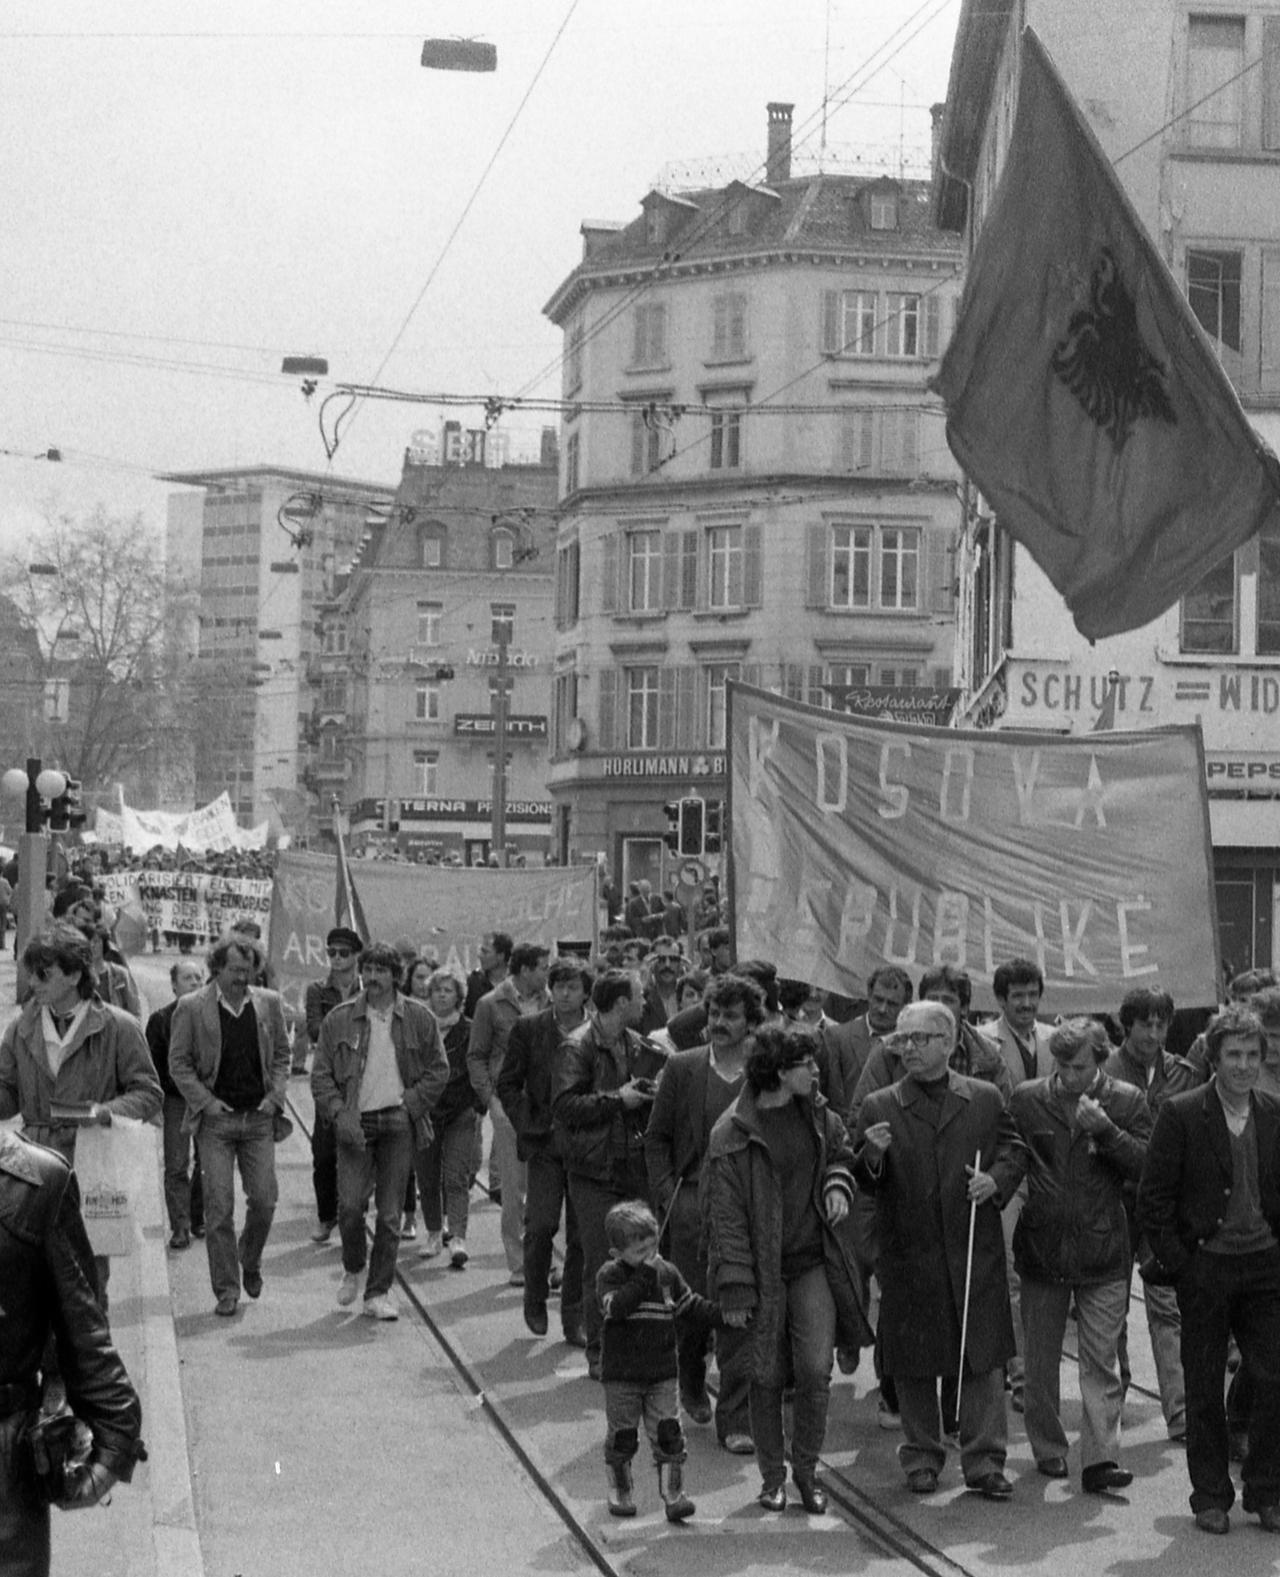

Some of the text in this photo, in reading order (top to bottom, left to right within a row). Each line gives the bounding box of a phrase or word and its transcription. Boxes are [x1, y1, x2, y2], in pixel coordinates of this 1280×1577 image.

[845, 688, 951, 711] Restaurant
[1022, 671, 1154, 712] SCHUTZ
[749, 716, 1107, 830] KOSOVA
